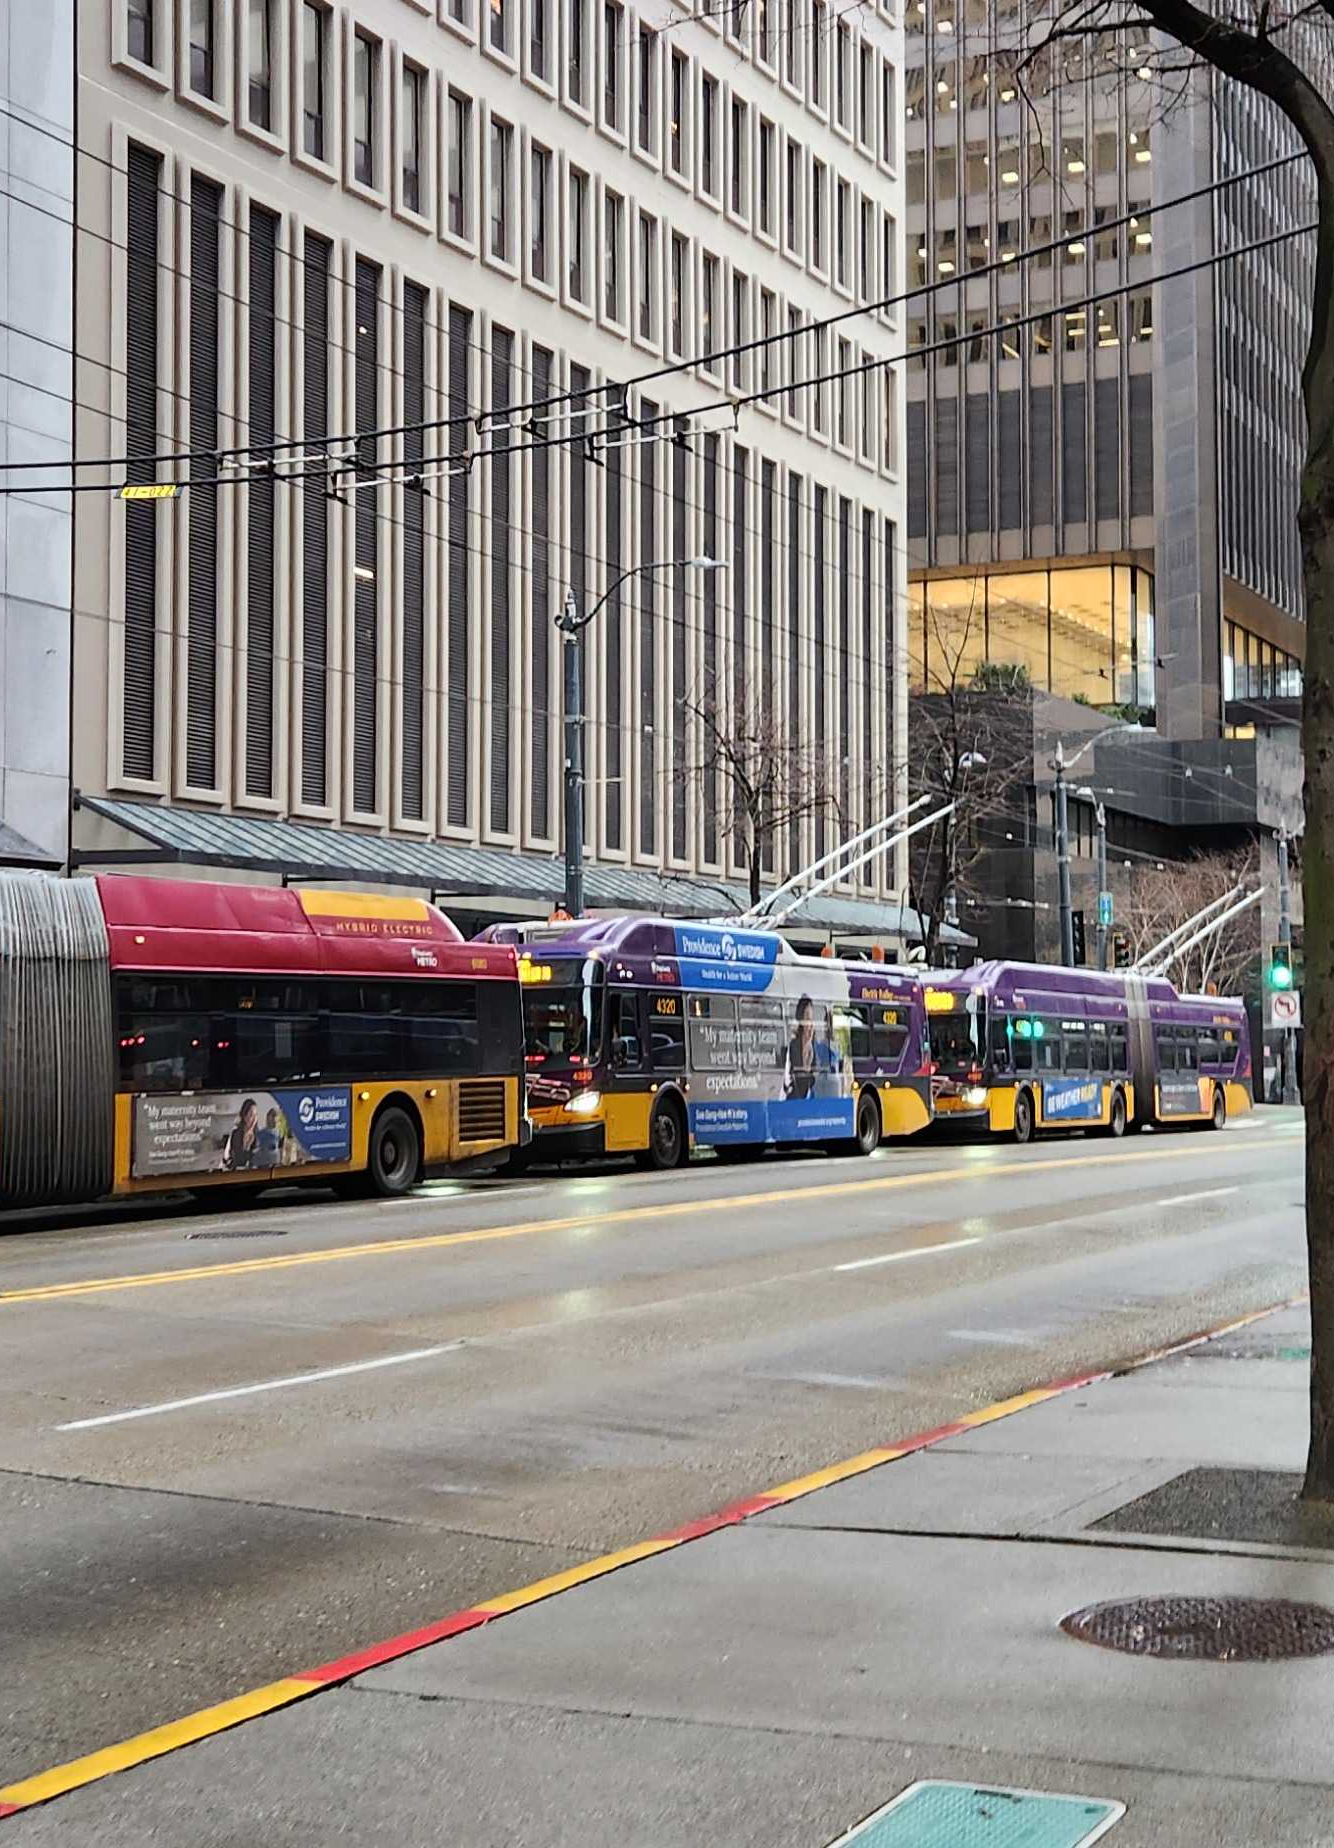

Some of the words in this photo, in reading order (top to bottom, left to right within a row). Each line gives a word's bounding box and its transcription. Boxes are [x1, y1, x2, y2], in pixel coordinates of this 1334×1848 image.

[336, 922, 378, 934] HYBRID
[383, 924, 433, 935] ELECTRIC
[682, 936, 722, 957] Providence
[657, 998, 675, 1014] 4320
[718, 1027, 756, 1048] maternity
[758, 1029, 777, 1043] team
[748, 1048, 776, 1069] beyond
[161, 1106, 196, 1118] maternity
